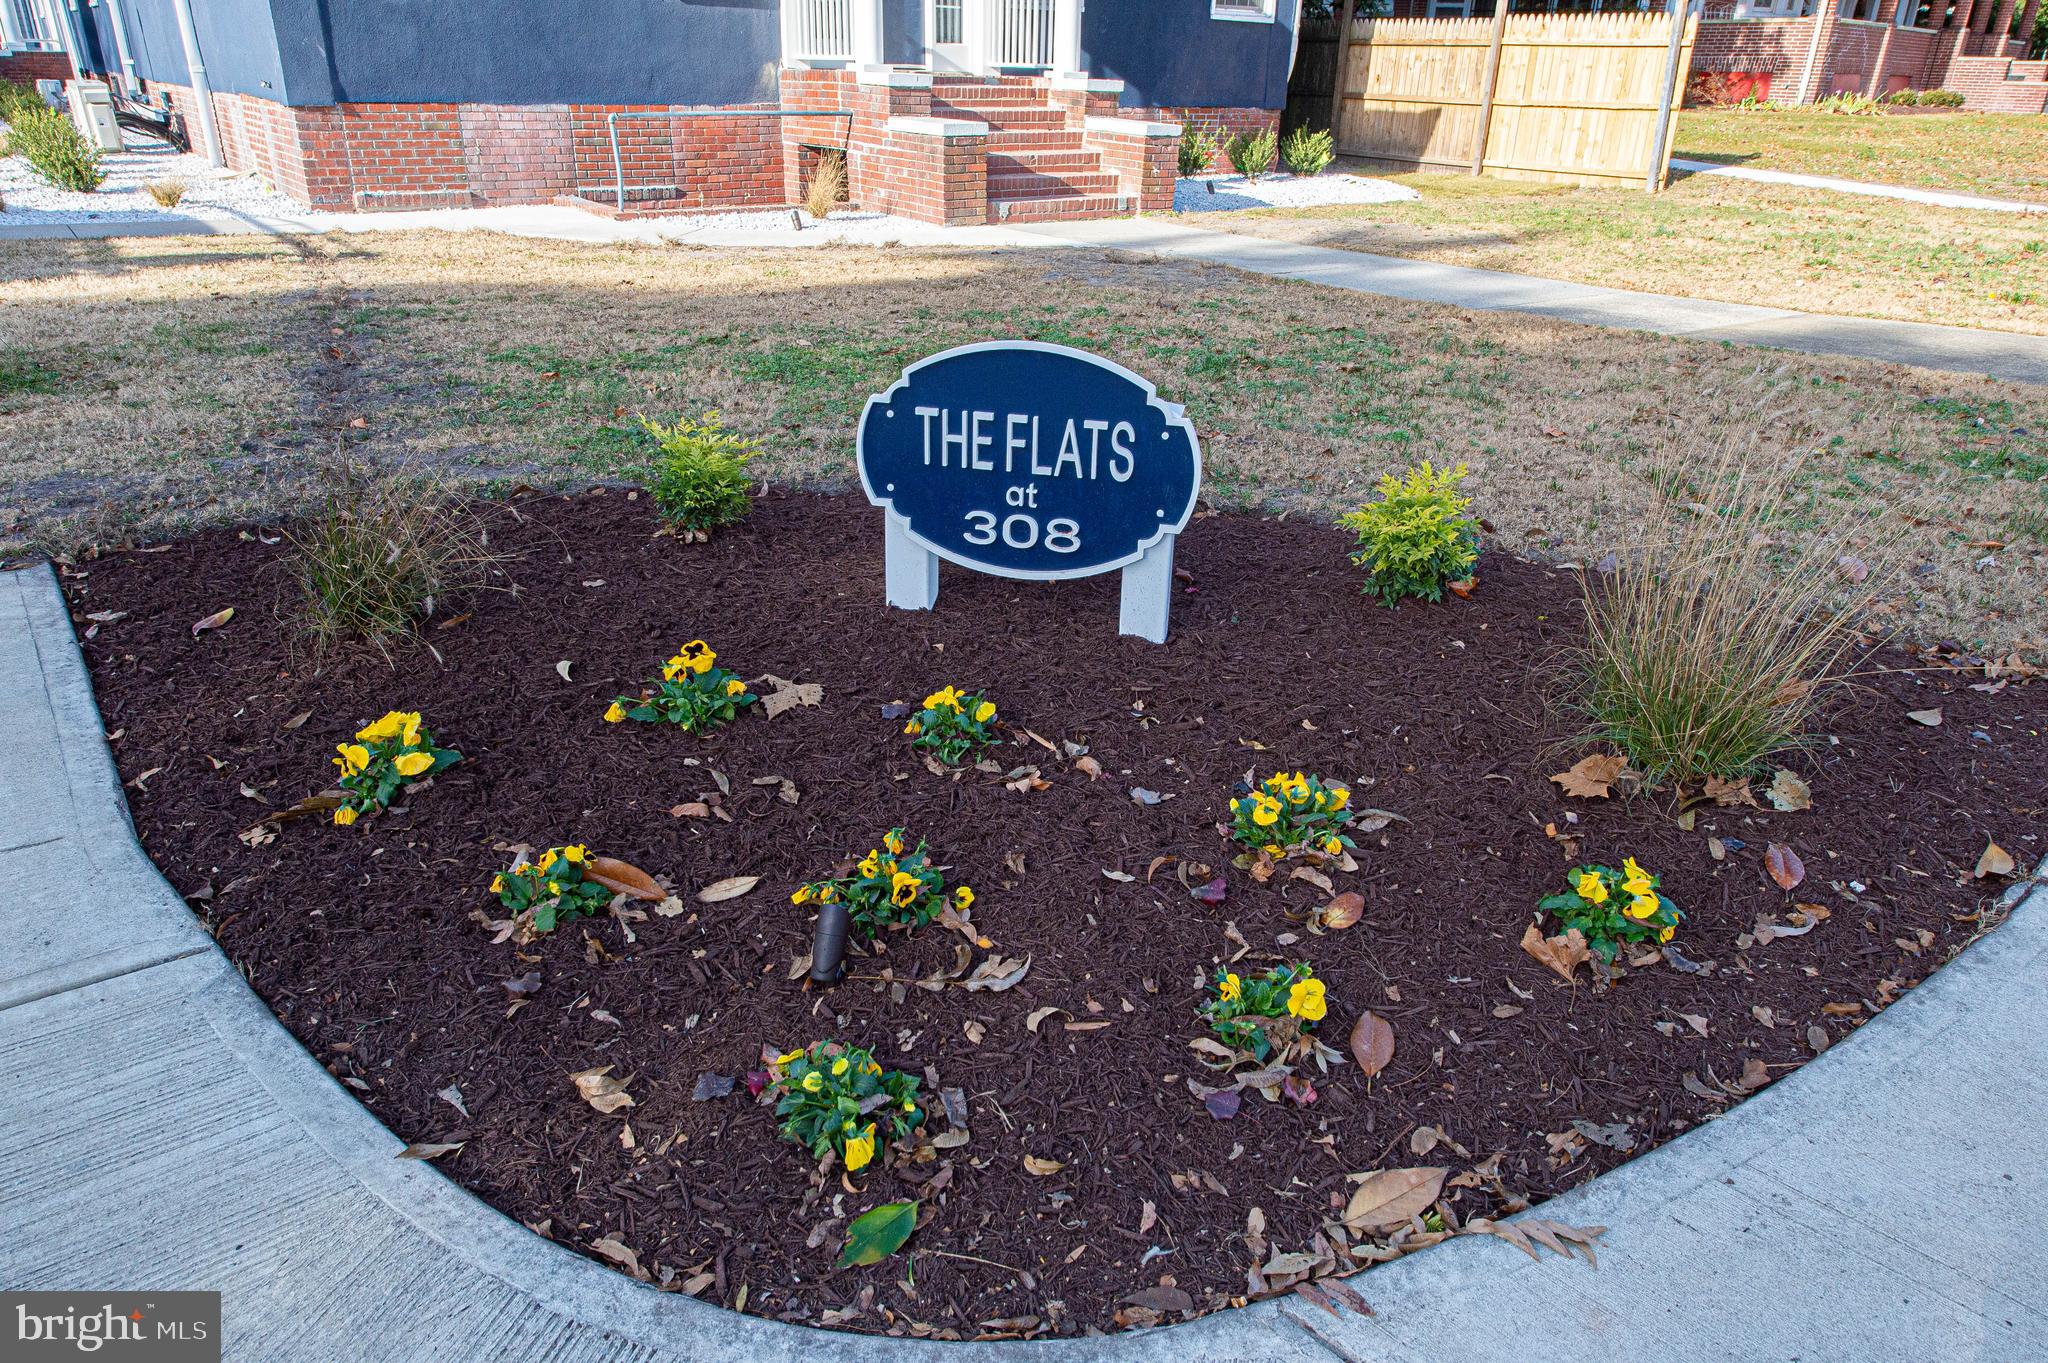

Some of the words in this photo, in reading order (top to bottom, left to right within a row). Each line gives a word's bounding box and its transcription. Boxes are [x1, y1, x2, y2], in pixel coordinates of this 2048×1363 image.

[915, 406, 994, 471] THE
[1005, 413, 1136, 482] FLATS
[1005, 482, 1038, 509] at
[963, 510, 1081, 553] 308
